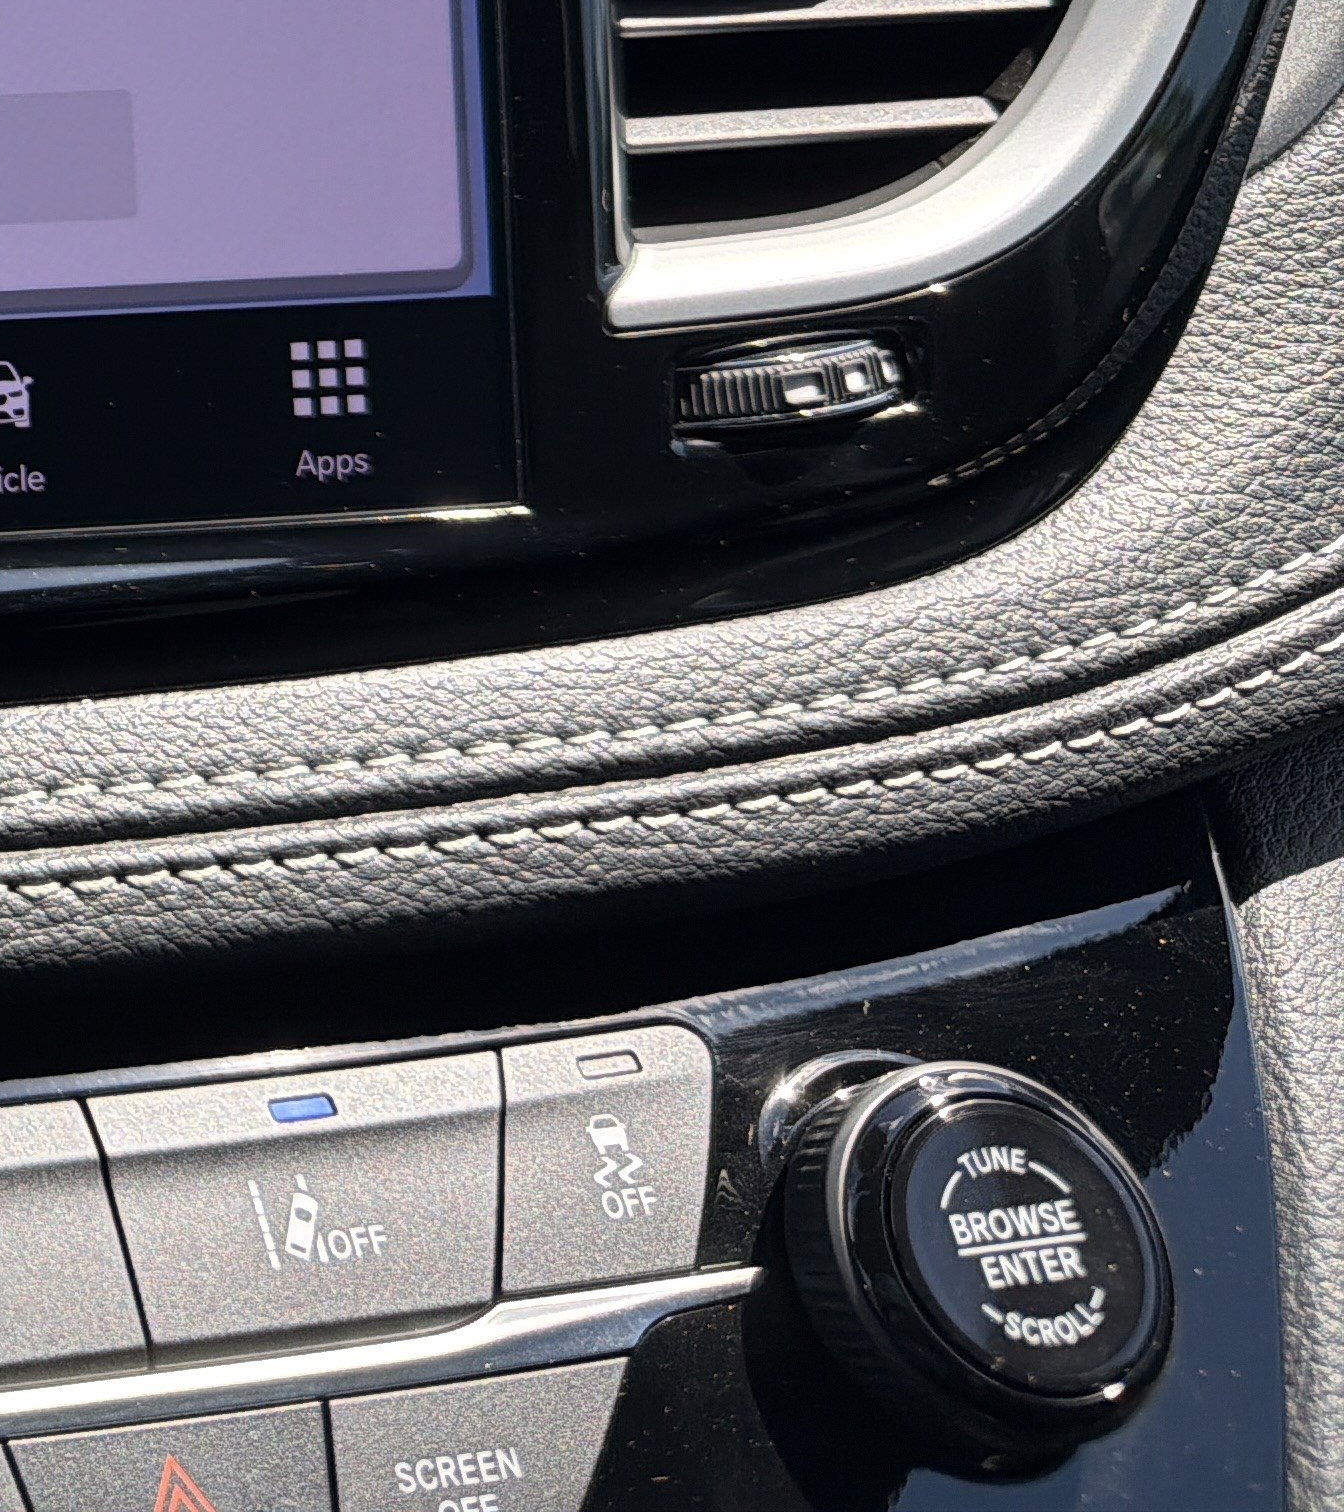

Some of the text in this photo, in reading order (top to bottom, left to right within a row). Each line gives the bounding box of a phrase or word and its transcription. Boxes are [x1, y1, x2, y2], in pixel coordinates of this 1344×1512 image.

[296, 449, 369, 482] Apps
[957, 1146, 1028, 1177] TUNE
[601, 1186, 657, 1220] OFF
[948, 1199, 1082, 1246] BROWSE
[327, 1225, 388, 1260] OFF
[980, 1247, 1088, 1290] ENTER
[1004, 1303, 1104, 1347] SCROLL
[394, 1446, 523, 1494] SCREEN
